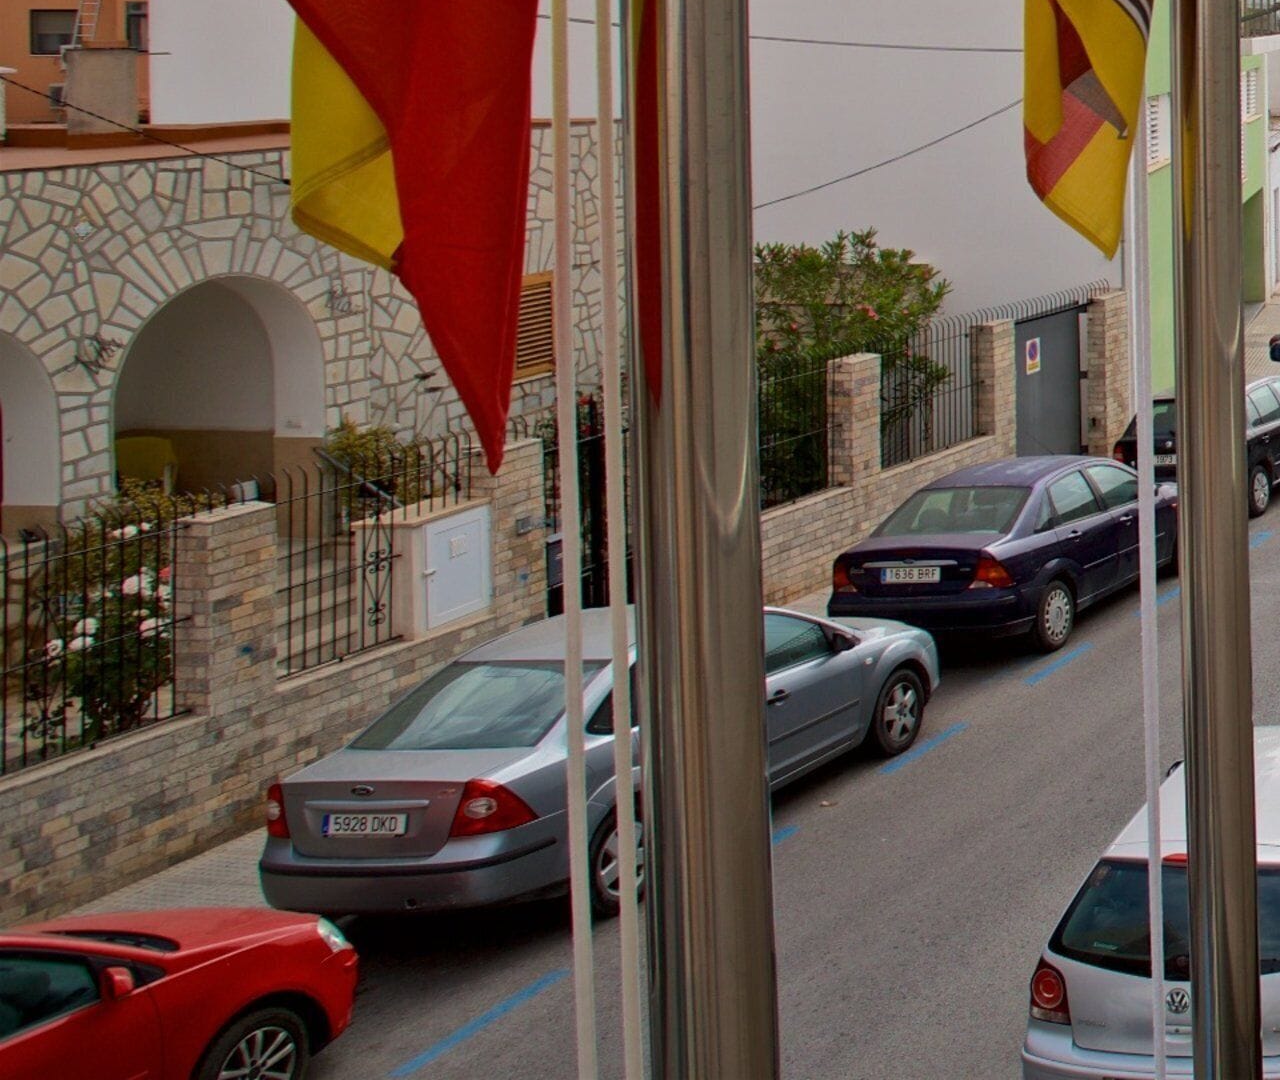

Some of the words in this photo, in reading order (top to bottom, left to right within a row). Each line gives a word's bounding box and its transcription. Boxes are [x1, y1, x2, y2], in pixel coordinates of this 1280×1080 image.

[889, 569, 914, 580] 1636
[334, 816, 368, 832] 5928
[371, 816, 398, 832] DKD
